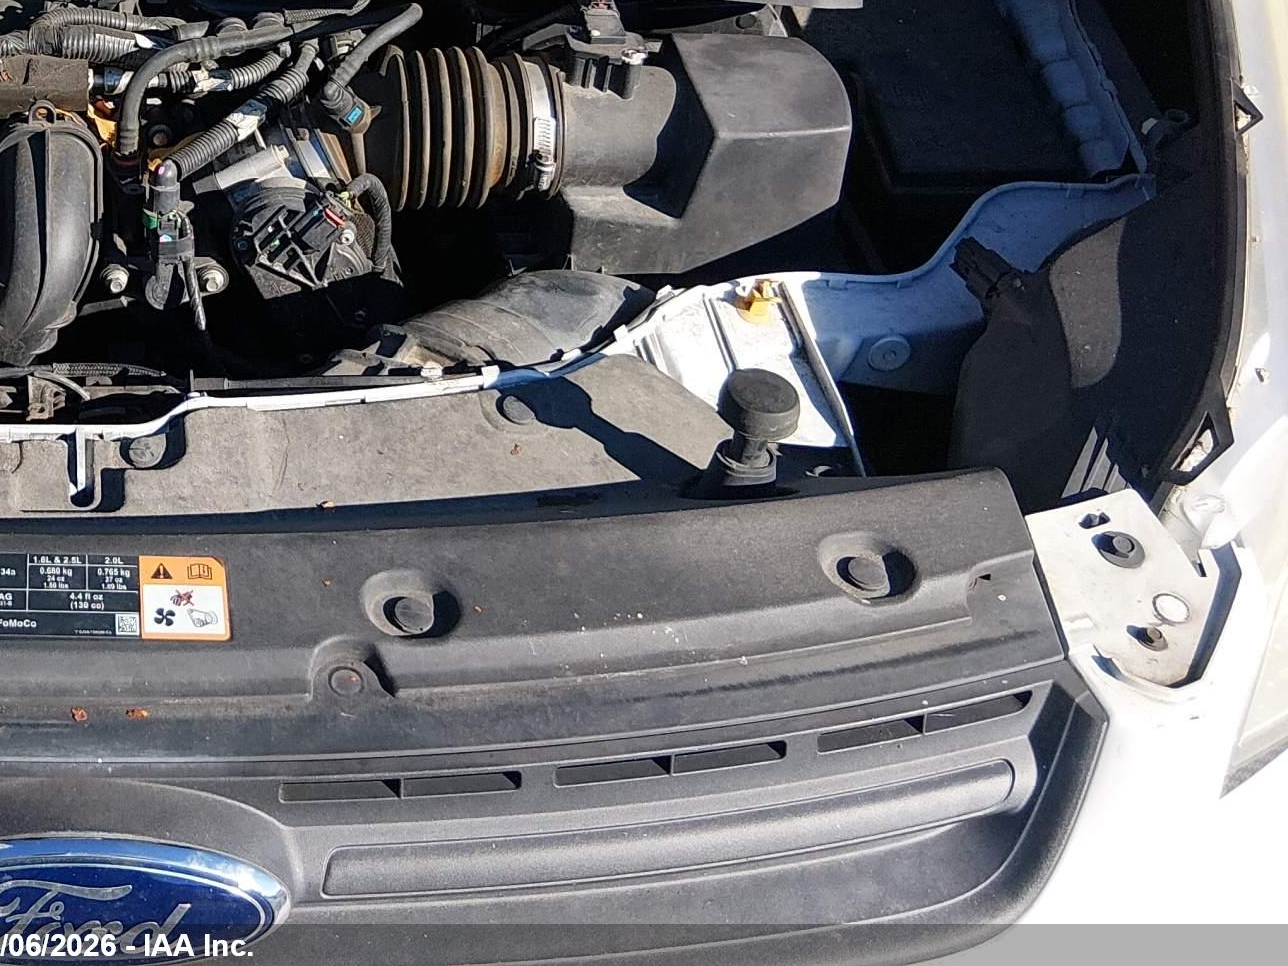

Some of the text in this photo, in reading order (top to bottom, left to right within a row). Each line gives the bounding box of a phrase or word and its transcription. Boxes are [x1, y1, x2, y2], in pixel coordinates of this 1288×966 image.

[53, 556, 61, 564] &
[63, 556, 82, 564] 2.5L
[104, 556, 124, 565] 2.0L
[39, 566, 73, 577] 0.680 kg
[97, 567, 131, 578] 0.765 kg
[69, 592, 83, 600] 4.4
[70, 601, 89, 610] (130
